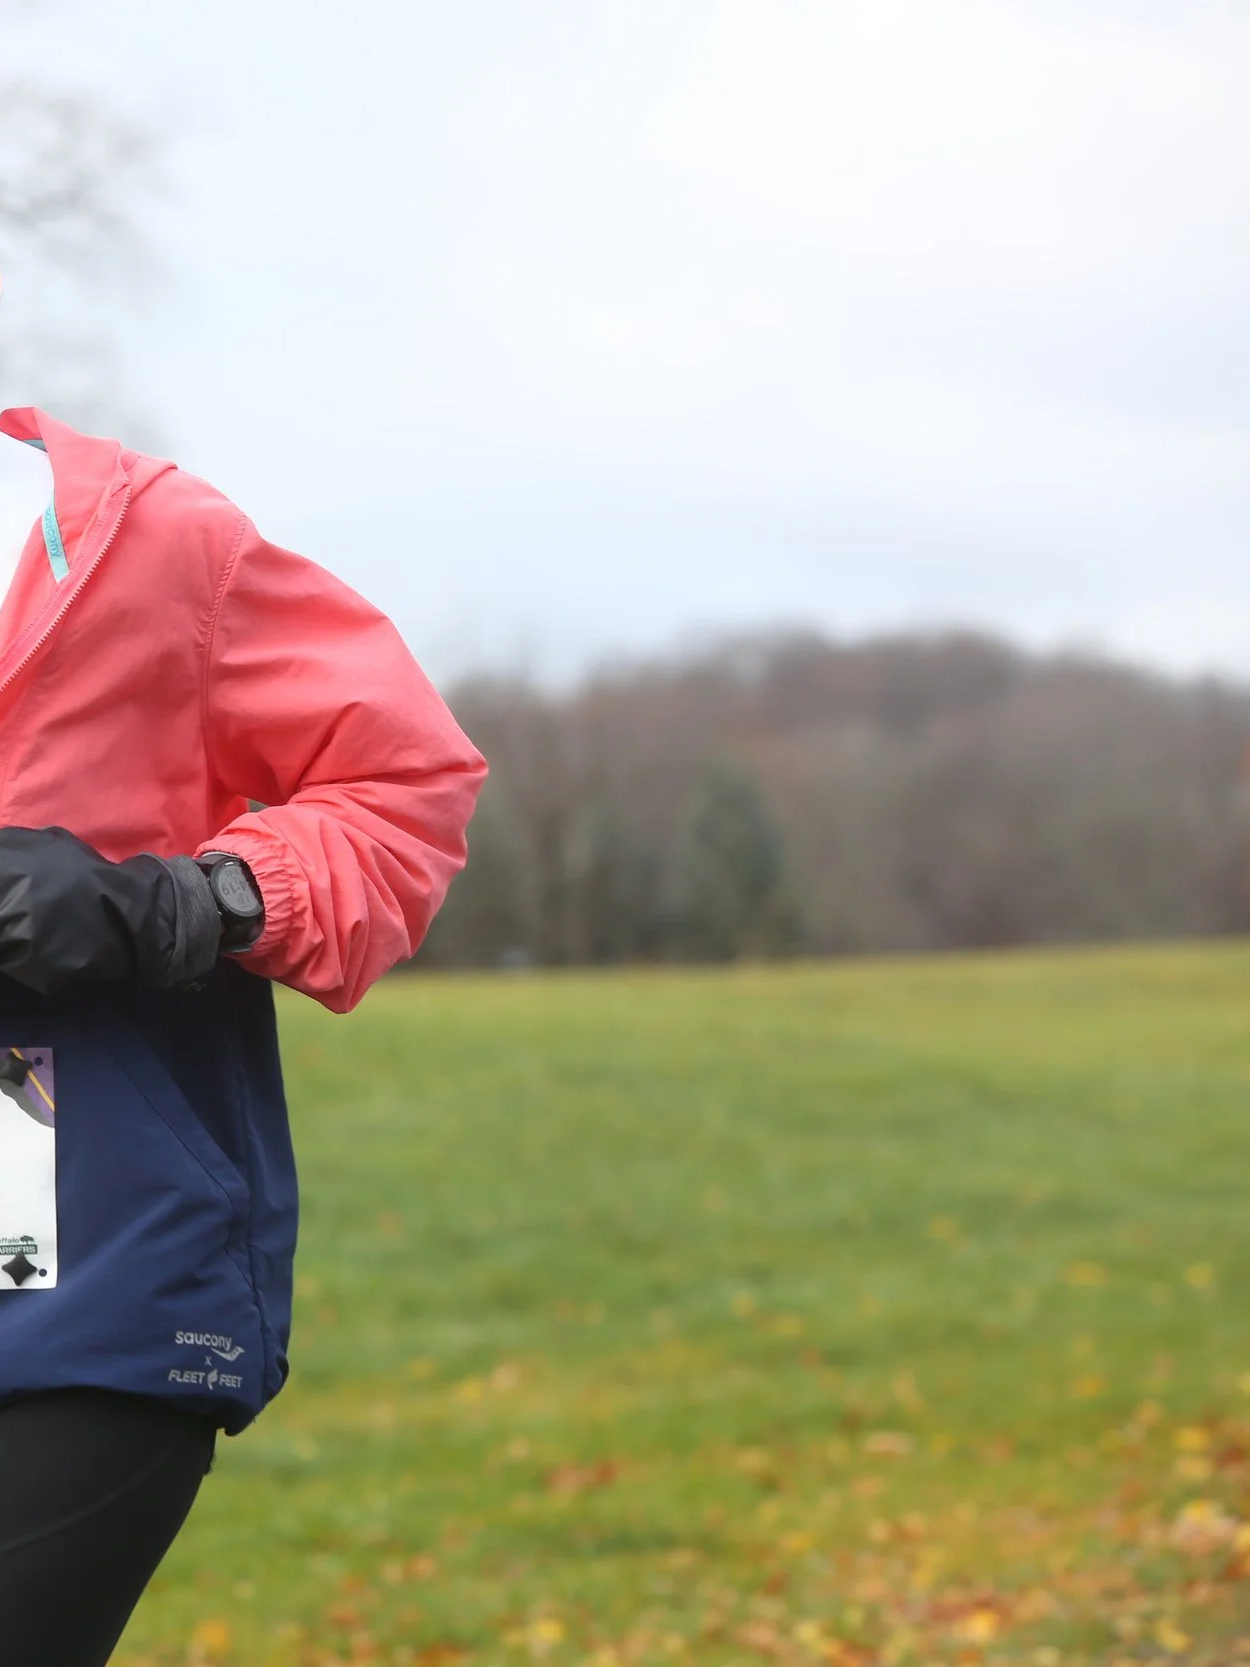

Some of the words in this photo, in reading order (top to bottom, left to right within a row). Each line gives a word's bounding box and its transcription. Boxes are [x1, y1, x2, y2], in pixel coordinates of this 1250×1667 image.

[175, 1331, 232, 1352] saucony
[168, 1369, 205, 1384] FLEET
[219, 1374, 243, 1388] FEET
